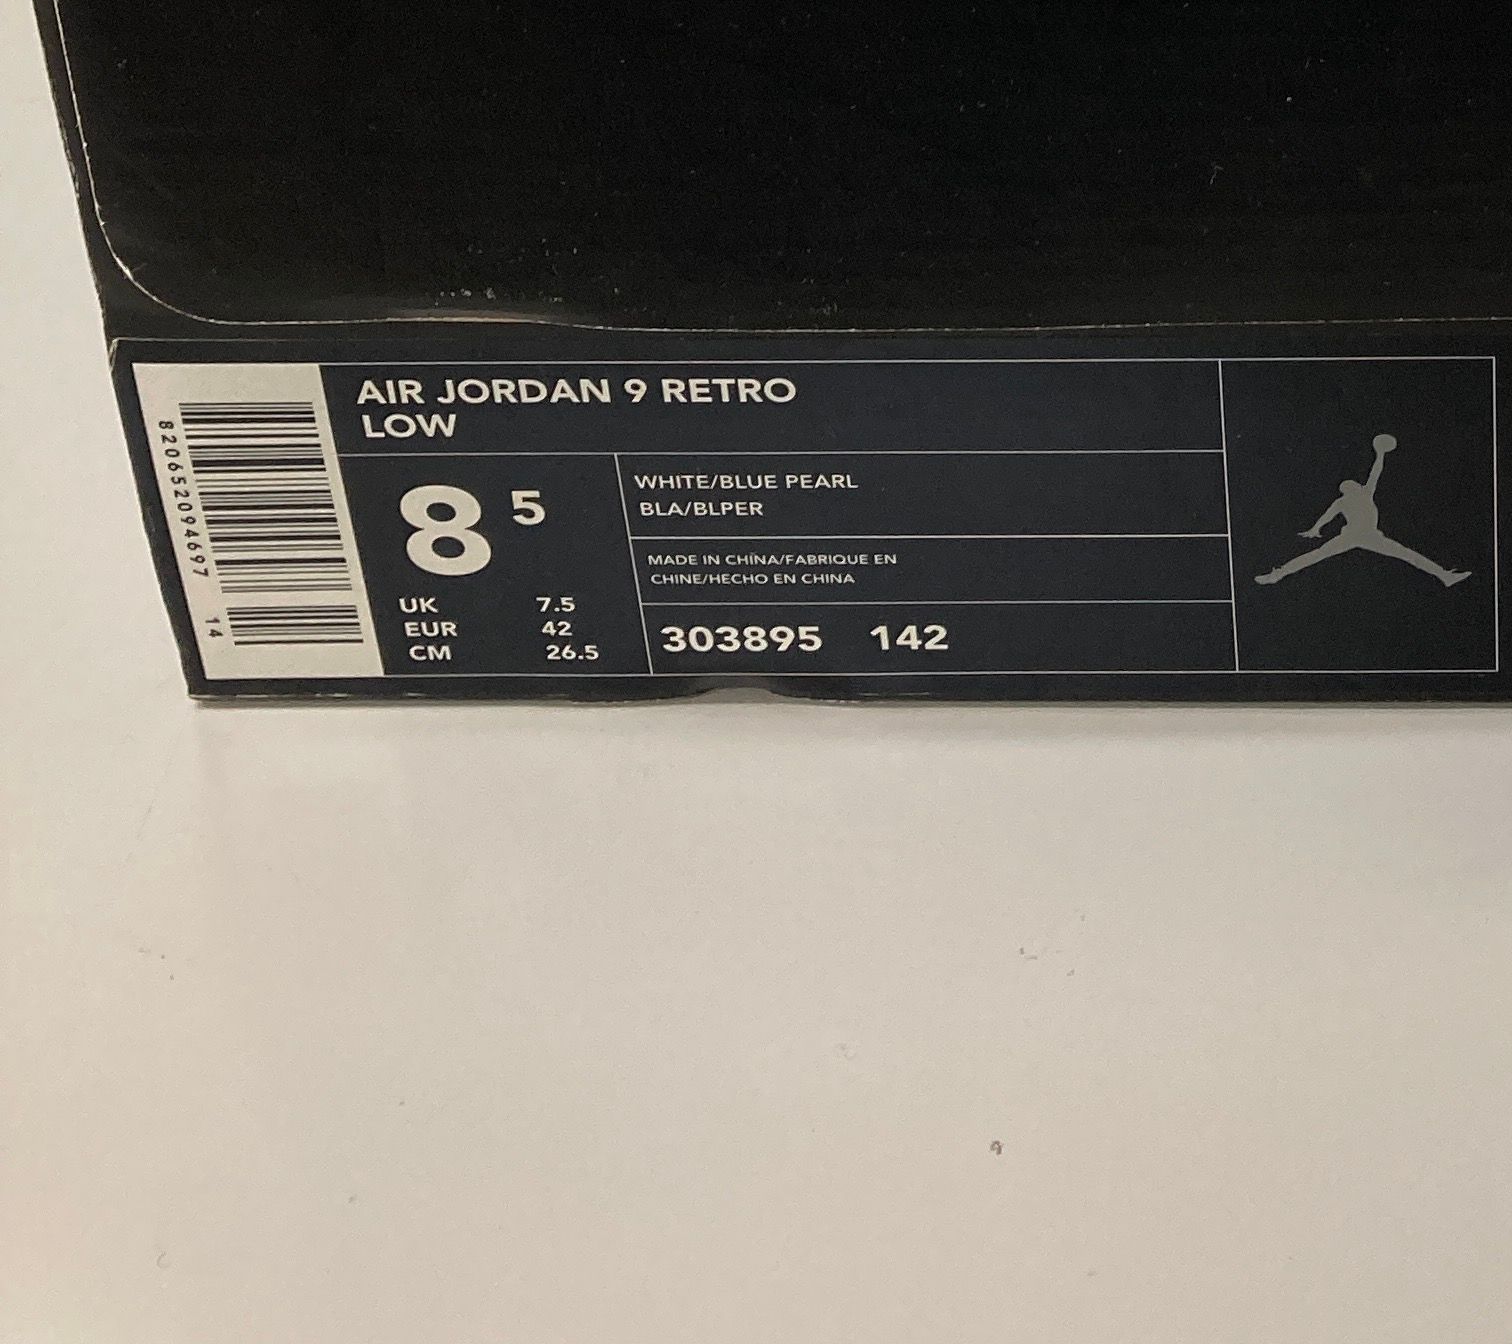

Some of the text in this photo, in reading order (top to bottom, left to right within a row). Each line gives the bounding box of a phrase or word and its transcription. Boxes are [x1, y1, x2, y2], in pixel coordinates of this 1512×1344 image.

[357, 378, 797, 405] AIR JORDAN 9 RETRO
[363, 414, 457, 438] LOW
[634, 474, 858, 490] WHITE/BLUE PEARL
[158, 420, 209, 577] 820652094697
[511, 490, 546, 526] 5
[639, 502, 763, 516] BLA/BLPER
[400, 485, 492, 577] 8
[648, 554, 697, 566] MADE
[703, 554, 720, 565] IN
[875, 554, 897, 564] EN
[651, 573, 855, 585] CHINE/HECHO EN CHINA
[400, 597, 576, 613] UK 7.5
[205, 617, 223, 638] 14
[405, 621, 573, 637] EUR 42
[660, 625, 949, 653] 303895 142
[410, 644, 600, 661] CM 26.5
